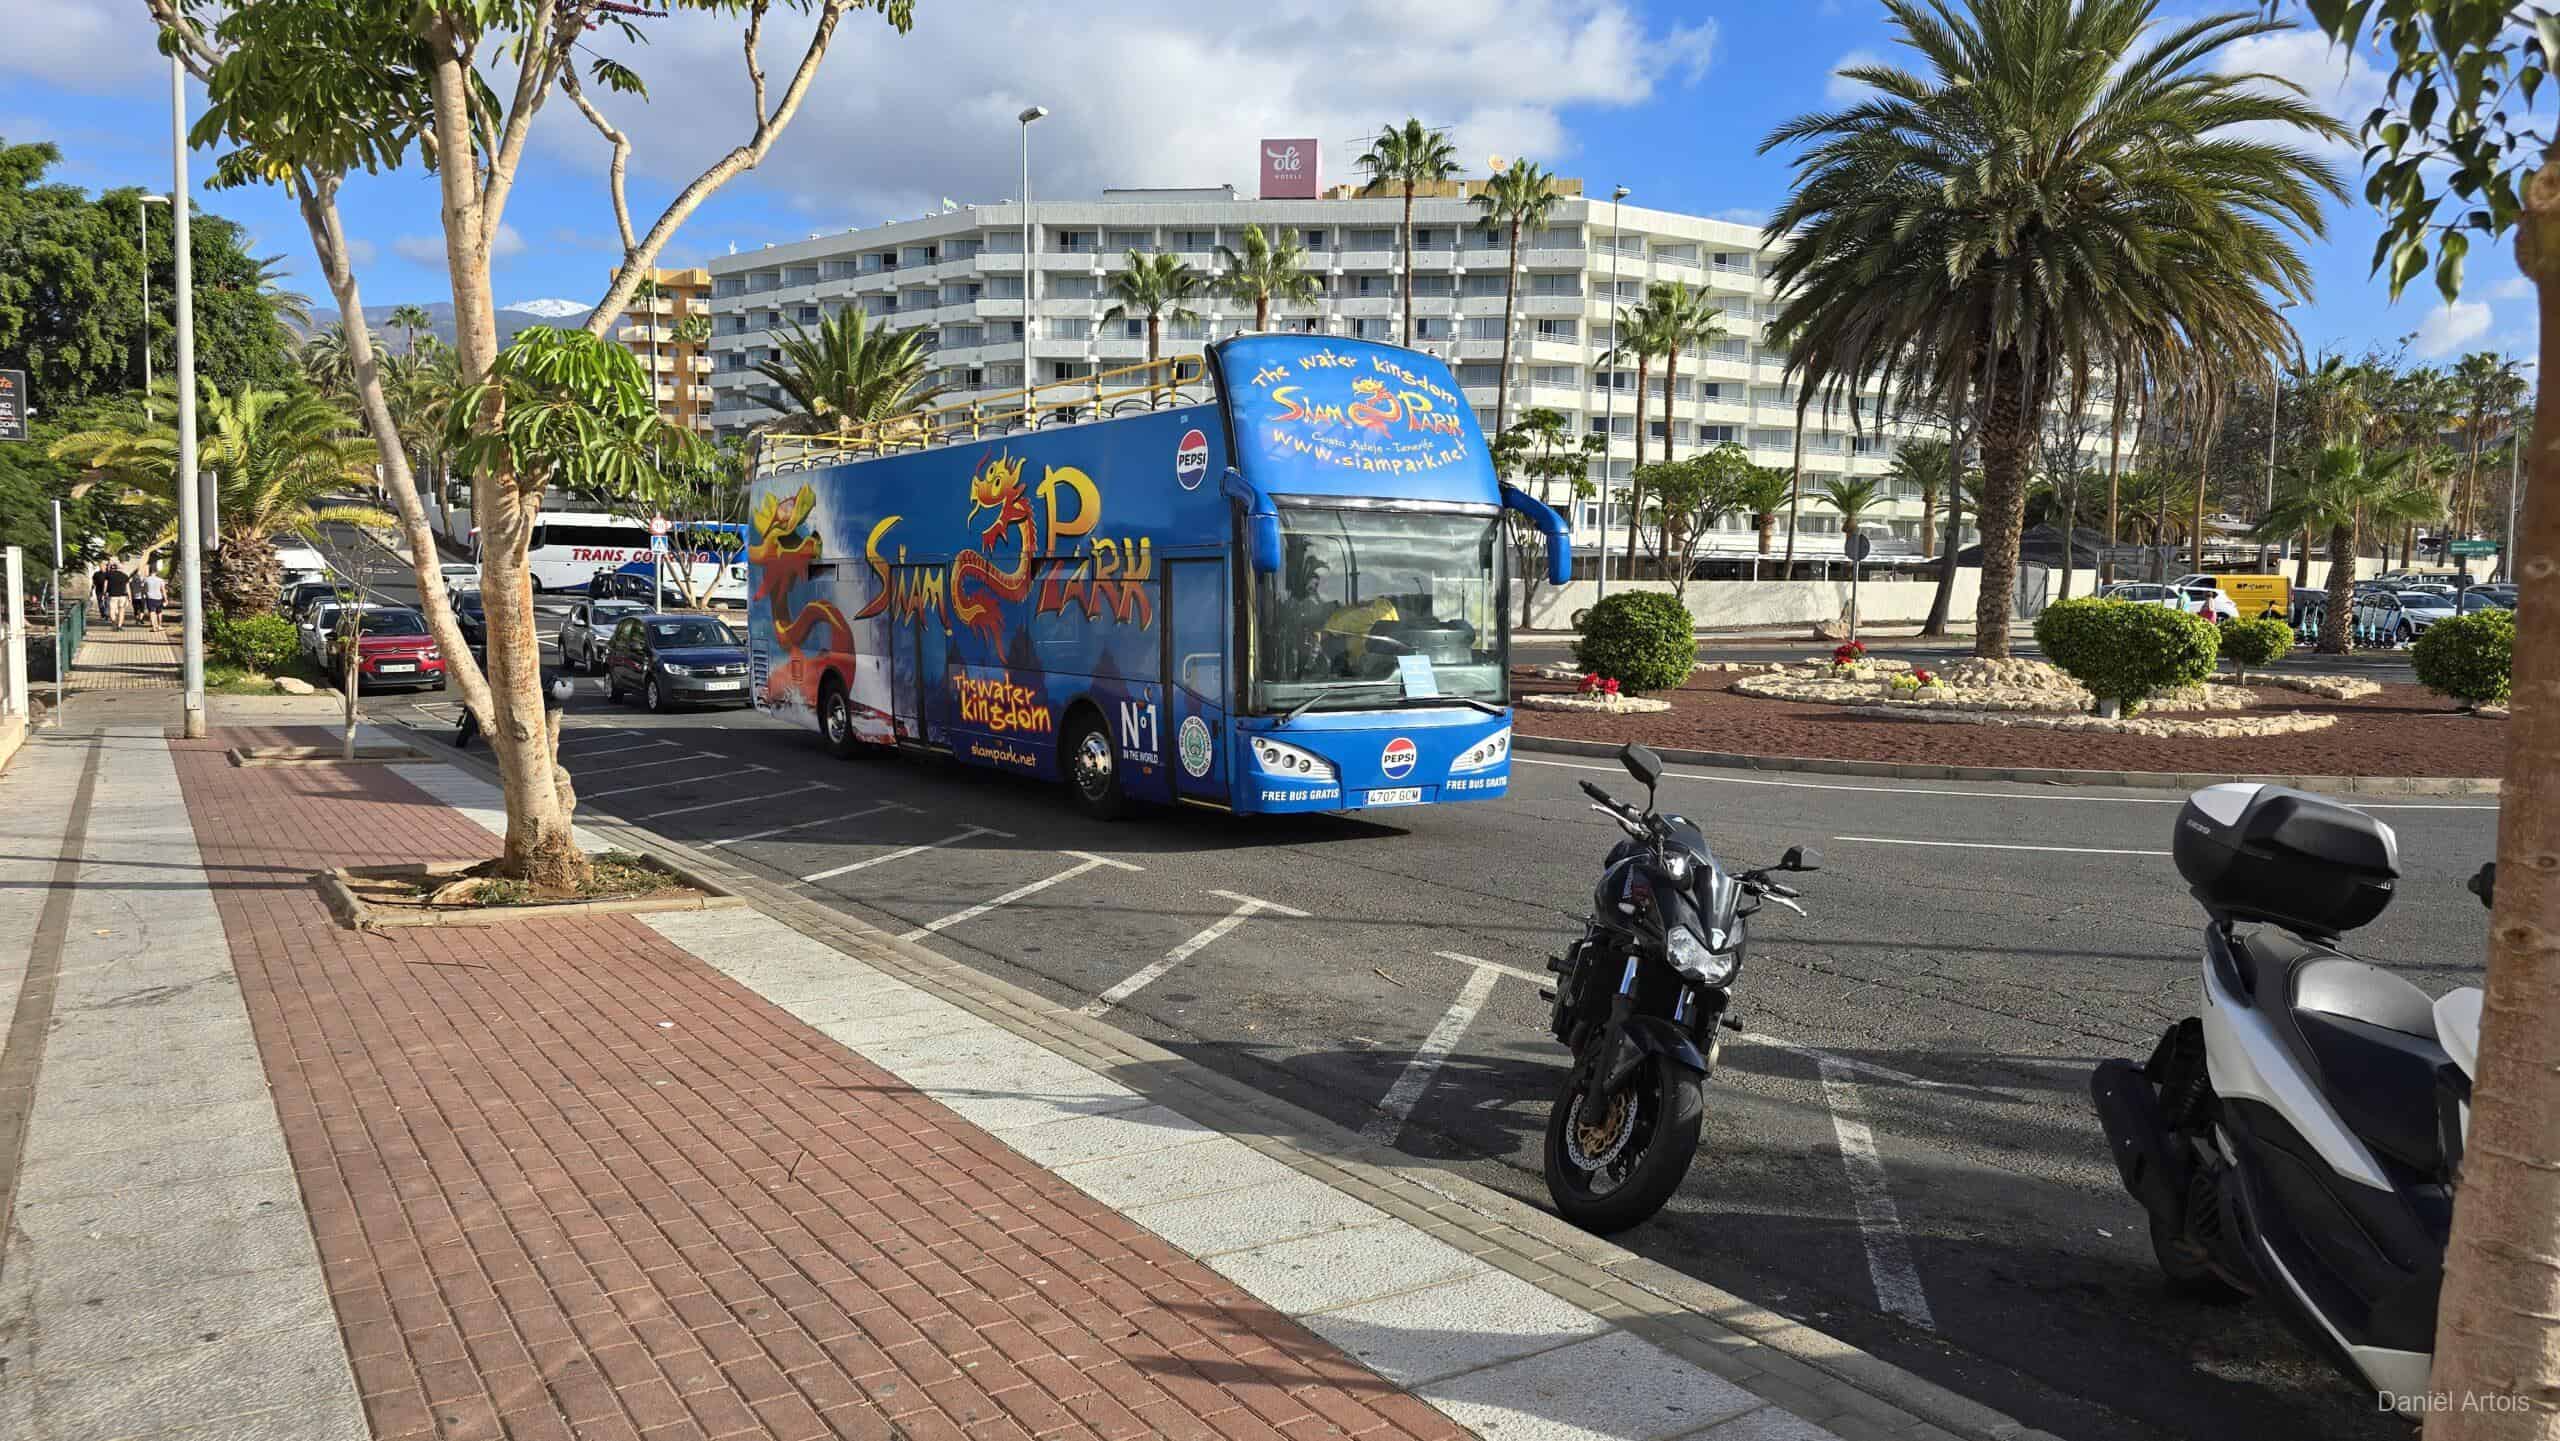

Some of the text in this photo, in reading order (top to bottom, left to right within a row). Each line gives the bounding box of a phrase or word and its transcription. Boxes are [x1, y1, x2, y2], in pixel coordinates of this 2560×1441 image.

[1252, 349, 1459, 406] The water kingdom
[1311, 431, 1346, 448] Costa
[1392, 438, 1435, 453] Tenerife
[1178, 453, 1206, 466] PEPSI
[1272, 428, 1469, 477] www.siampark.net
[572, 548, 628, 562] TRANS.
[953, 669, 1036, 704] The water
[961, 690, 1053, 732] kingdom
[971, 741, 1037, 767] siampark.net
[1123, 749, 1158, 764] IN THE WORLD
[1384, 753, 1414, 763] PEPSI
[1446, 779, 1467, 790] FREE
[1469, 779, 1484, 789] BUS
[1262, 788, 1340, 801] FREE BUS GRATIS
